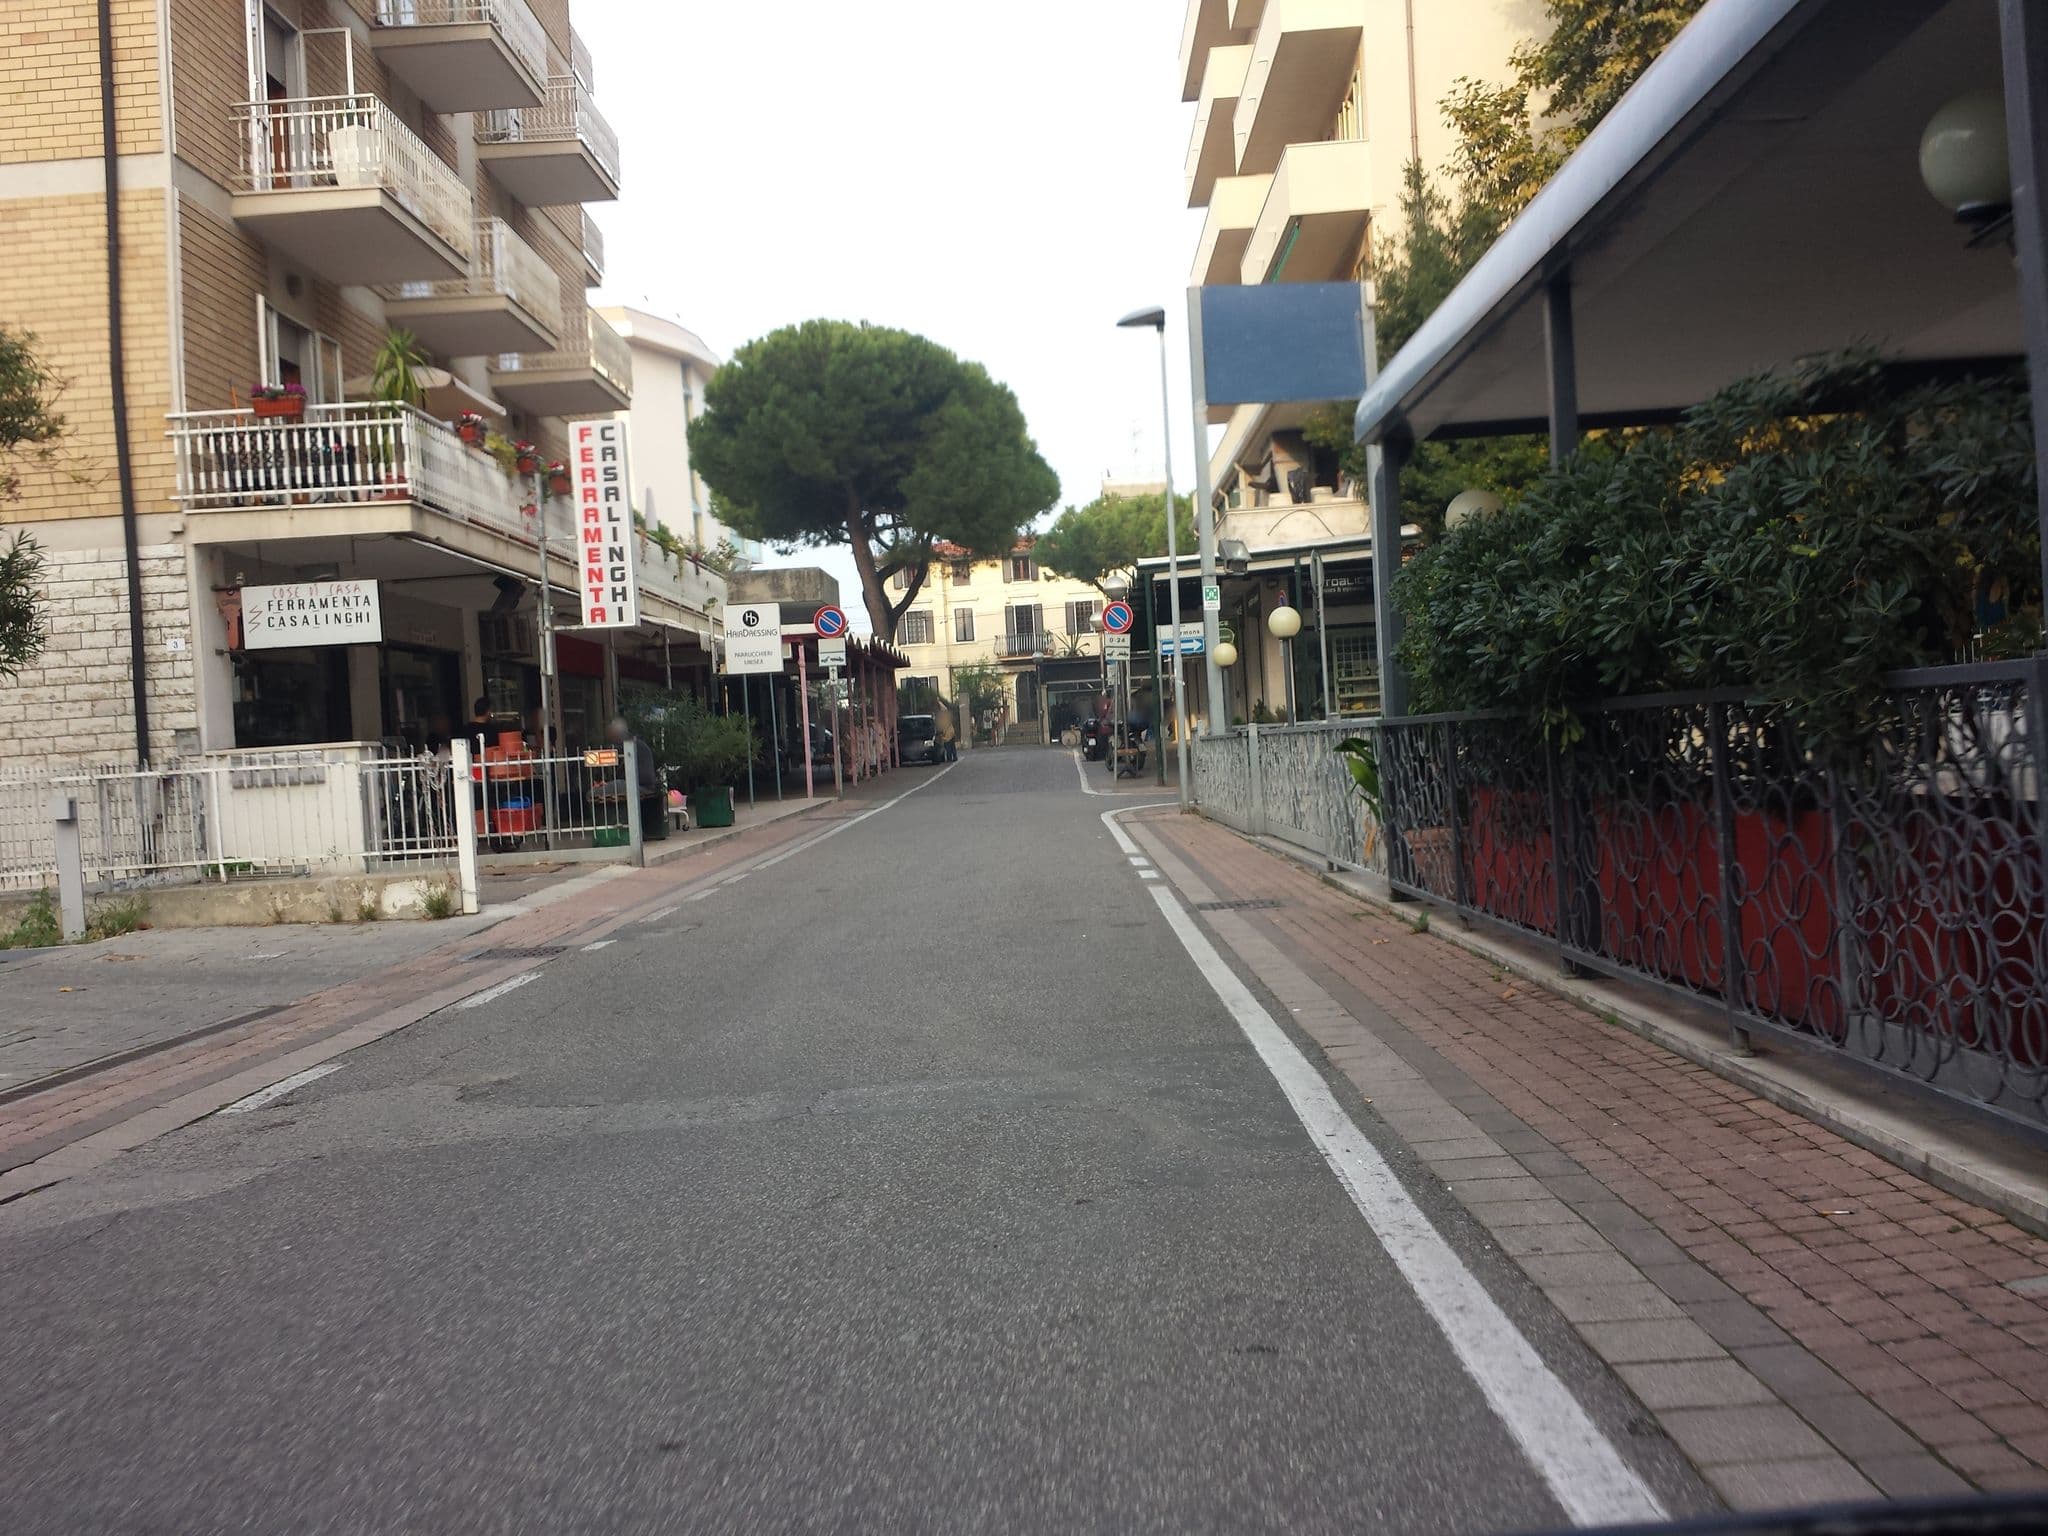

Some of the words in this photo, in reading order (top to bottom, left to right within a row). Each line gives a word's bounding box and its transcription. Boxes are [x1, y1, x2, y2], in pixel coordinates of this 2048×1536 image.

[578, 426, 607, 624] FERRAMENTA
[600, 425, 628, 623] CASALINGHI
[272, 586, 299, 600] COSE
[328, 583, 362, 597] CASA
[267, 595, 371, 612] FERRAMENTA
[267, 611, 370, 628] CASALINGHI
